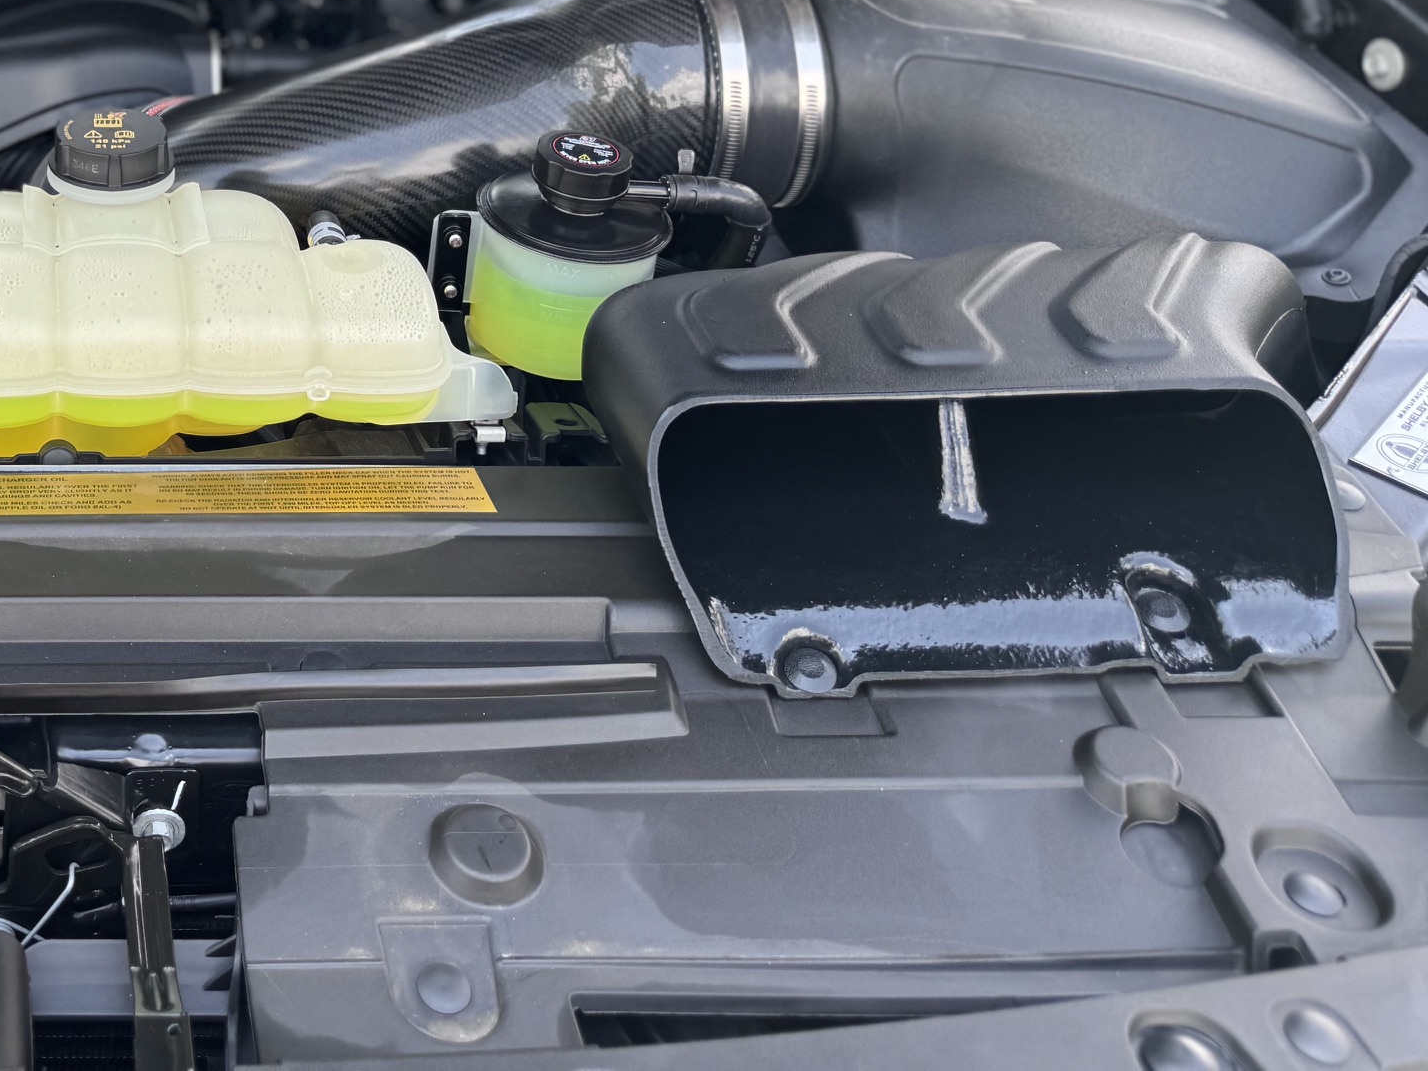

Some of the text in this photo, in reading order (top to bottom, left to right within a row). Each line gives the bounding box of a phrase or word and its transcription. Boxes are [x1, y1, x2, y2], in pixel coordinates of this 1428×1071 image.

[546, 262, 581, 279] MAX
[1401, 399, 1428, 432] SHELBY
[1407, 443, 1428, 471] SHELBY
